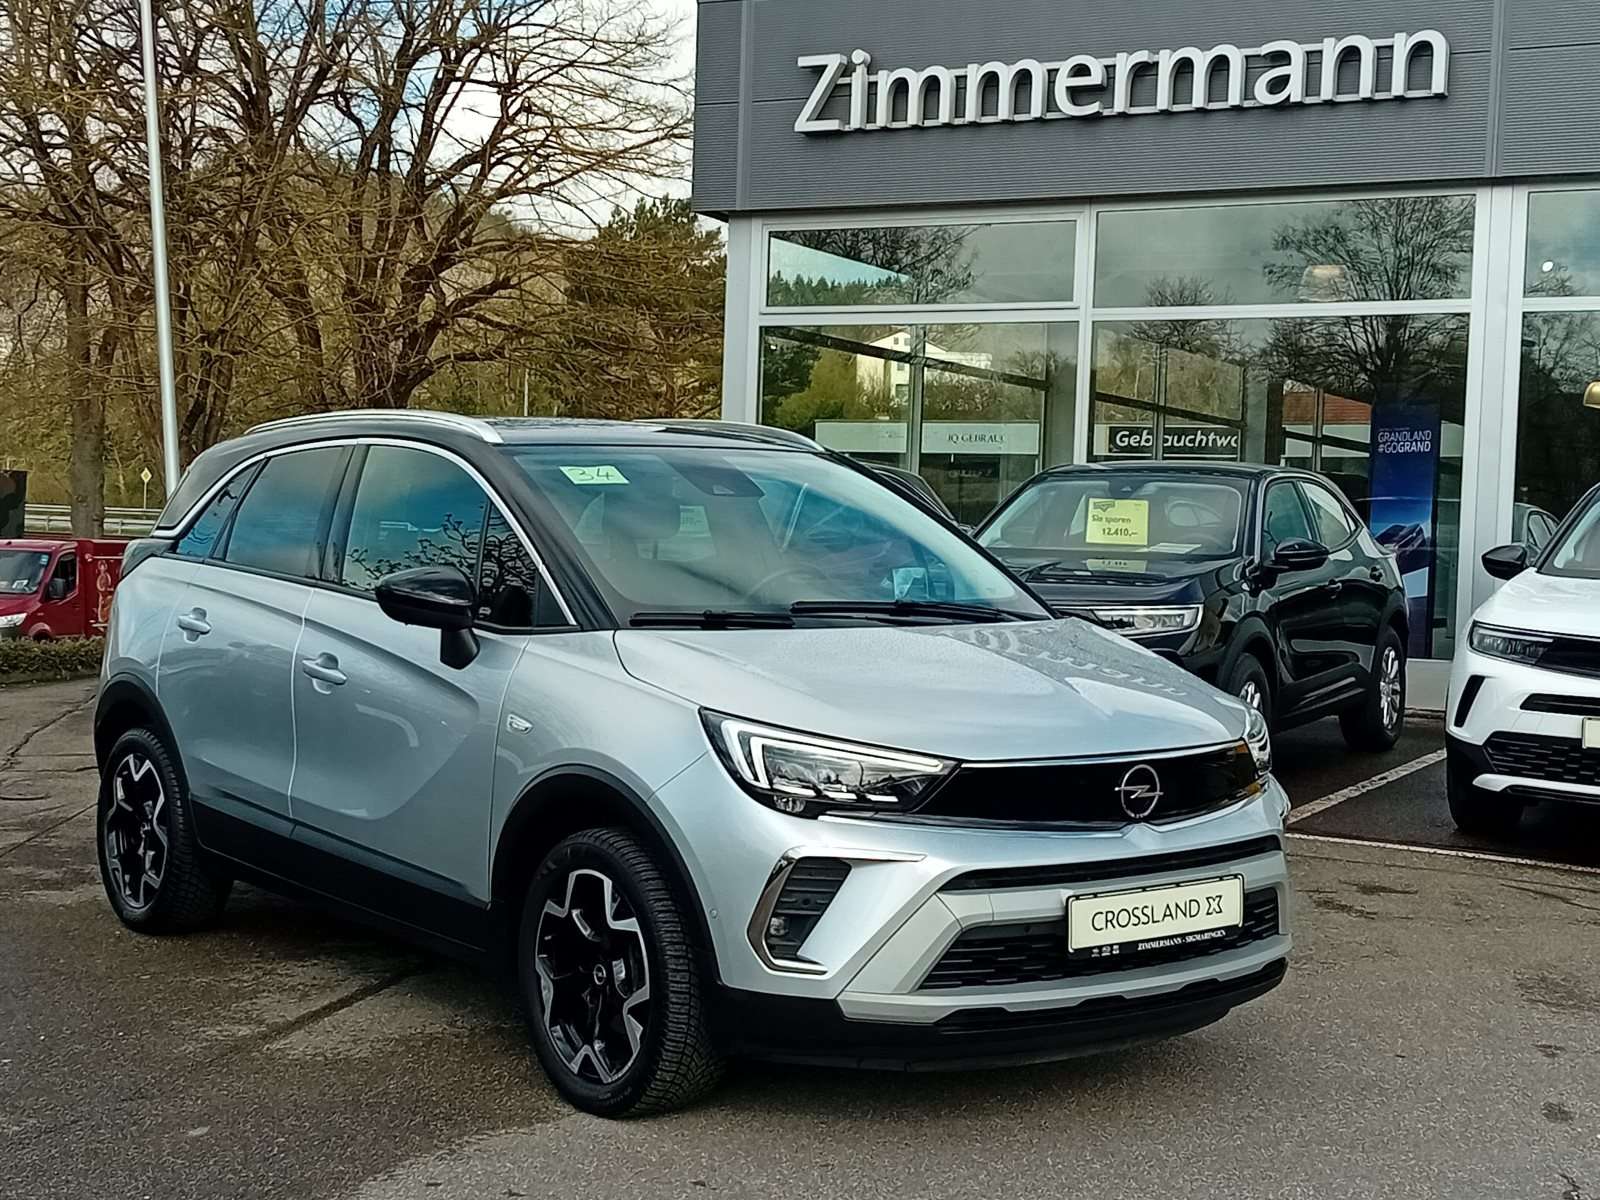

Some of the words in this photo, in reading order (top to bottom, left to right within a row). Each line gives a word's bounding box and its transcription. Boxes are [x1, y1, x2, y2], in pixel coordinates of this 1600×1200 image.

[793, 28, 1450, 134] Zimmermann
[1115, 429, 1238, 448] Gebauchtw
[1377, 430, 1432, 443] GRANDLAND
[1378, 441, 1431, 453] #GOGRAND
[567, 468, 615, 482] 34
[1091, 899, 1201, 932] CROSSLAND
[1205, 895, 1223, 916] X
